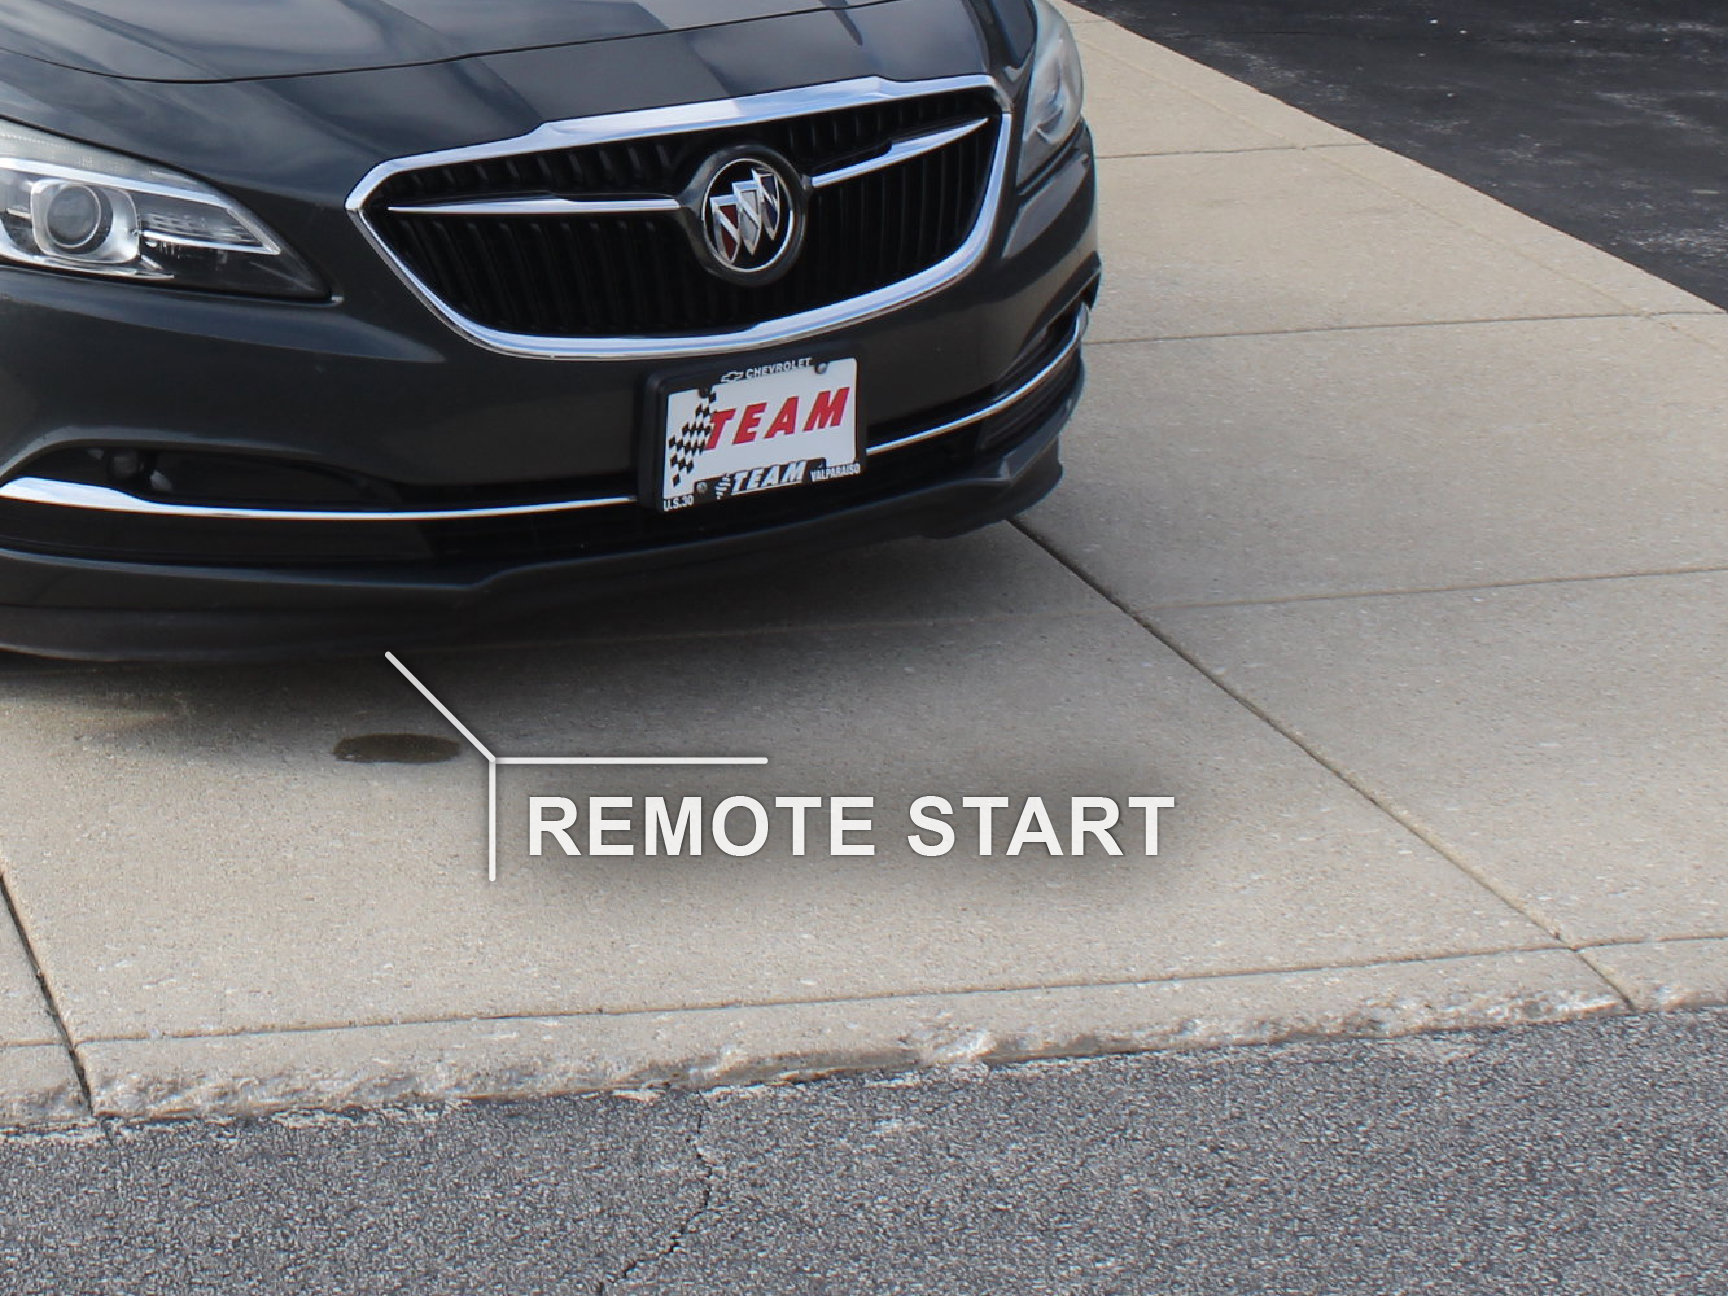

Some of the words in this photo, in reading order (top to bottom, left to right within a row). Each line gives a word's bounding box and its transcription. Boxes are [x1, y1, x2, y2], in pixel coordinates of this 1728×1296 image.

[746, 357, 812, 378] CHEVROLET
[705, 387, 850, 450] TEAM
[730, 460, 807, 495] TEAM
